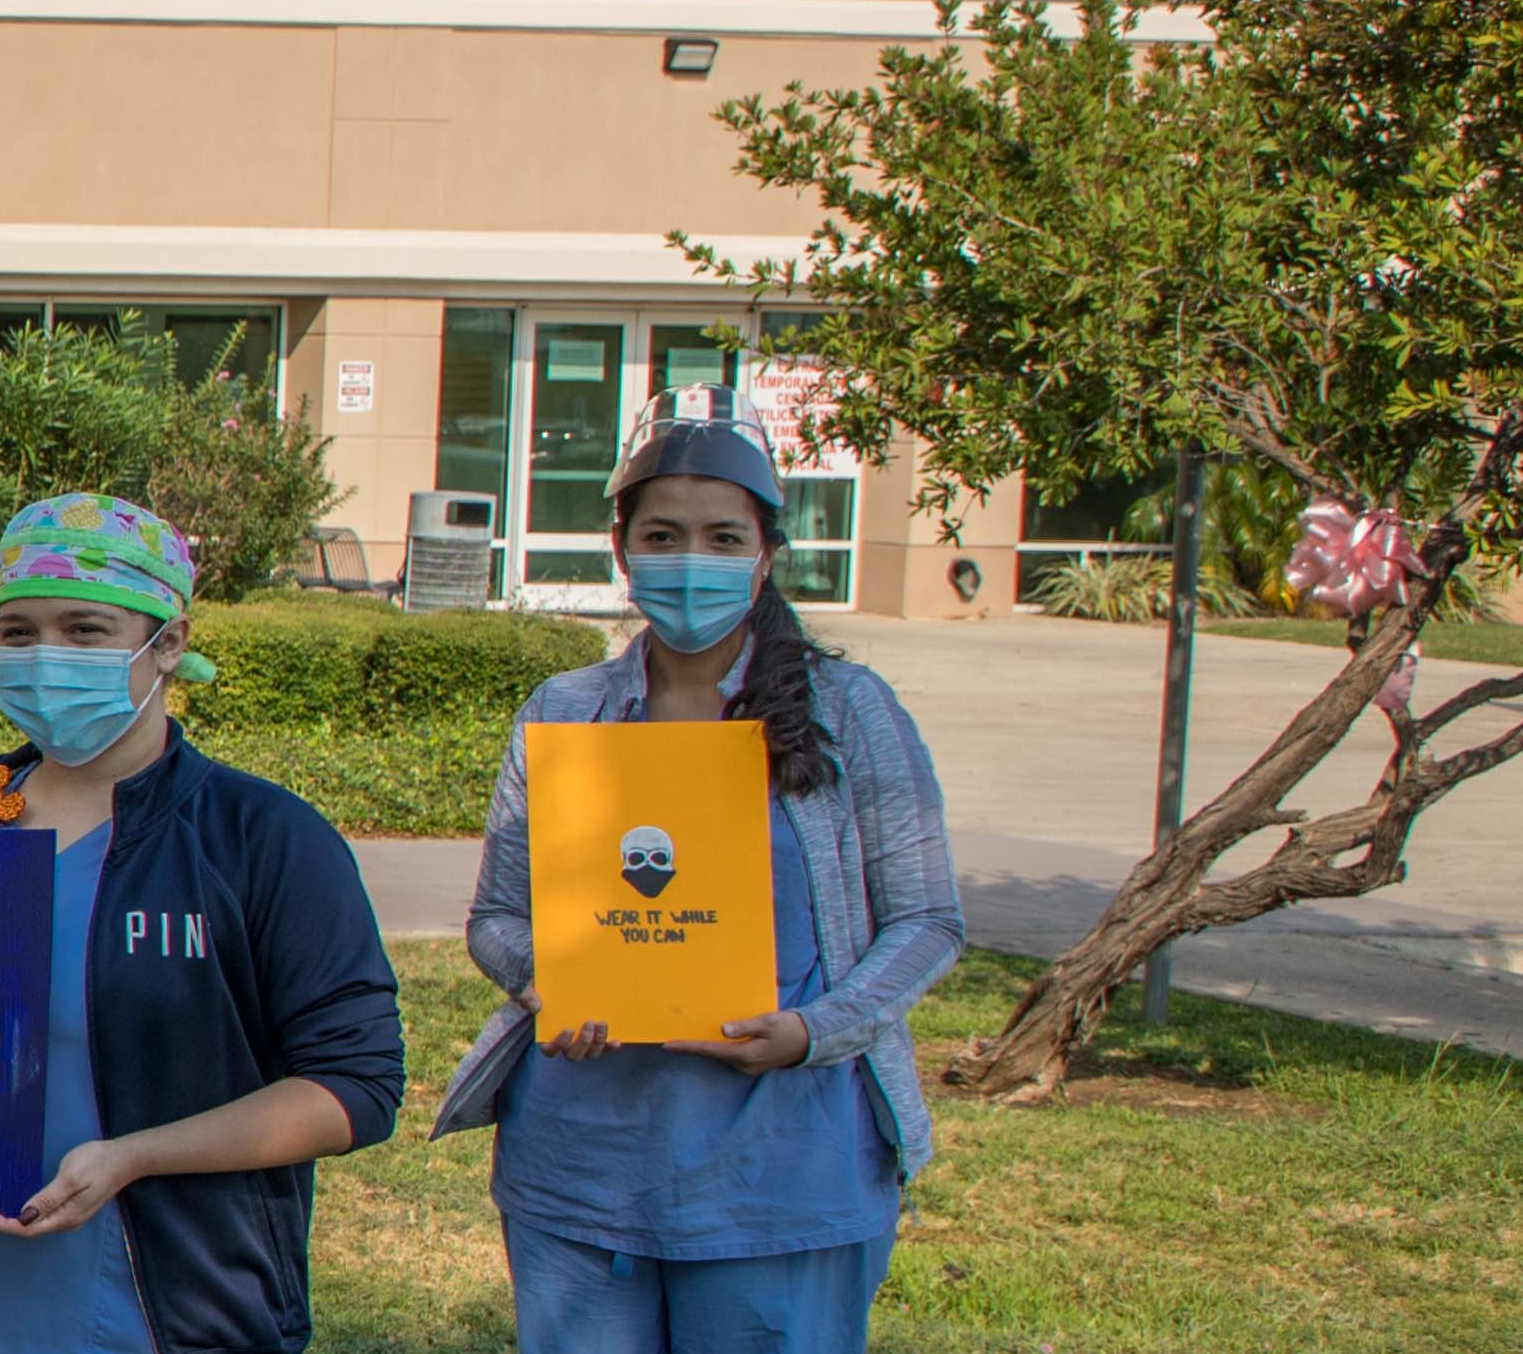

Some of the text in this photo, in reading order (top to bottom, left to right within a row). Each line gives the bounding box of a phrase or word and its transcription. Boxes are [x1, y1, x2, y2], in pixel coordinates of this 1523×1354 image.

[594, 909, 718, 926] WEAR IT WHILE
[125, 910, 207, 959] PIN
[620, 927, 685, 944] YOU CAN
